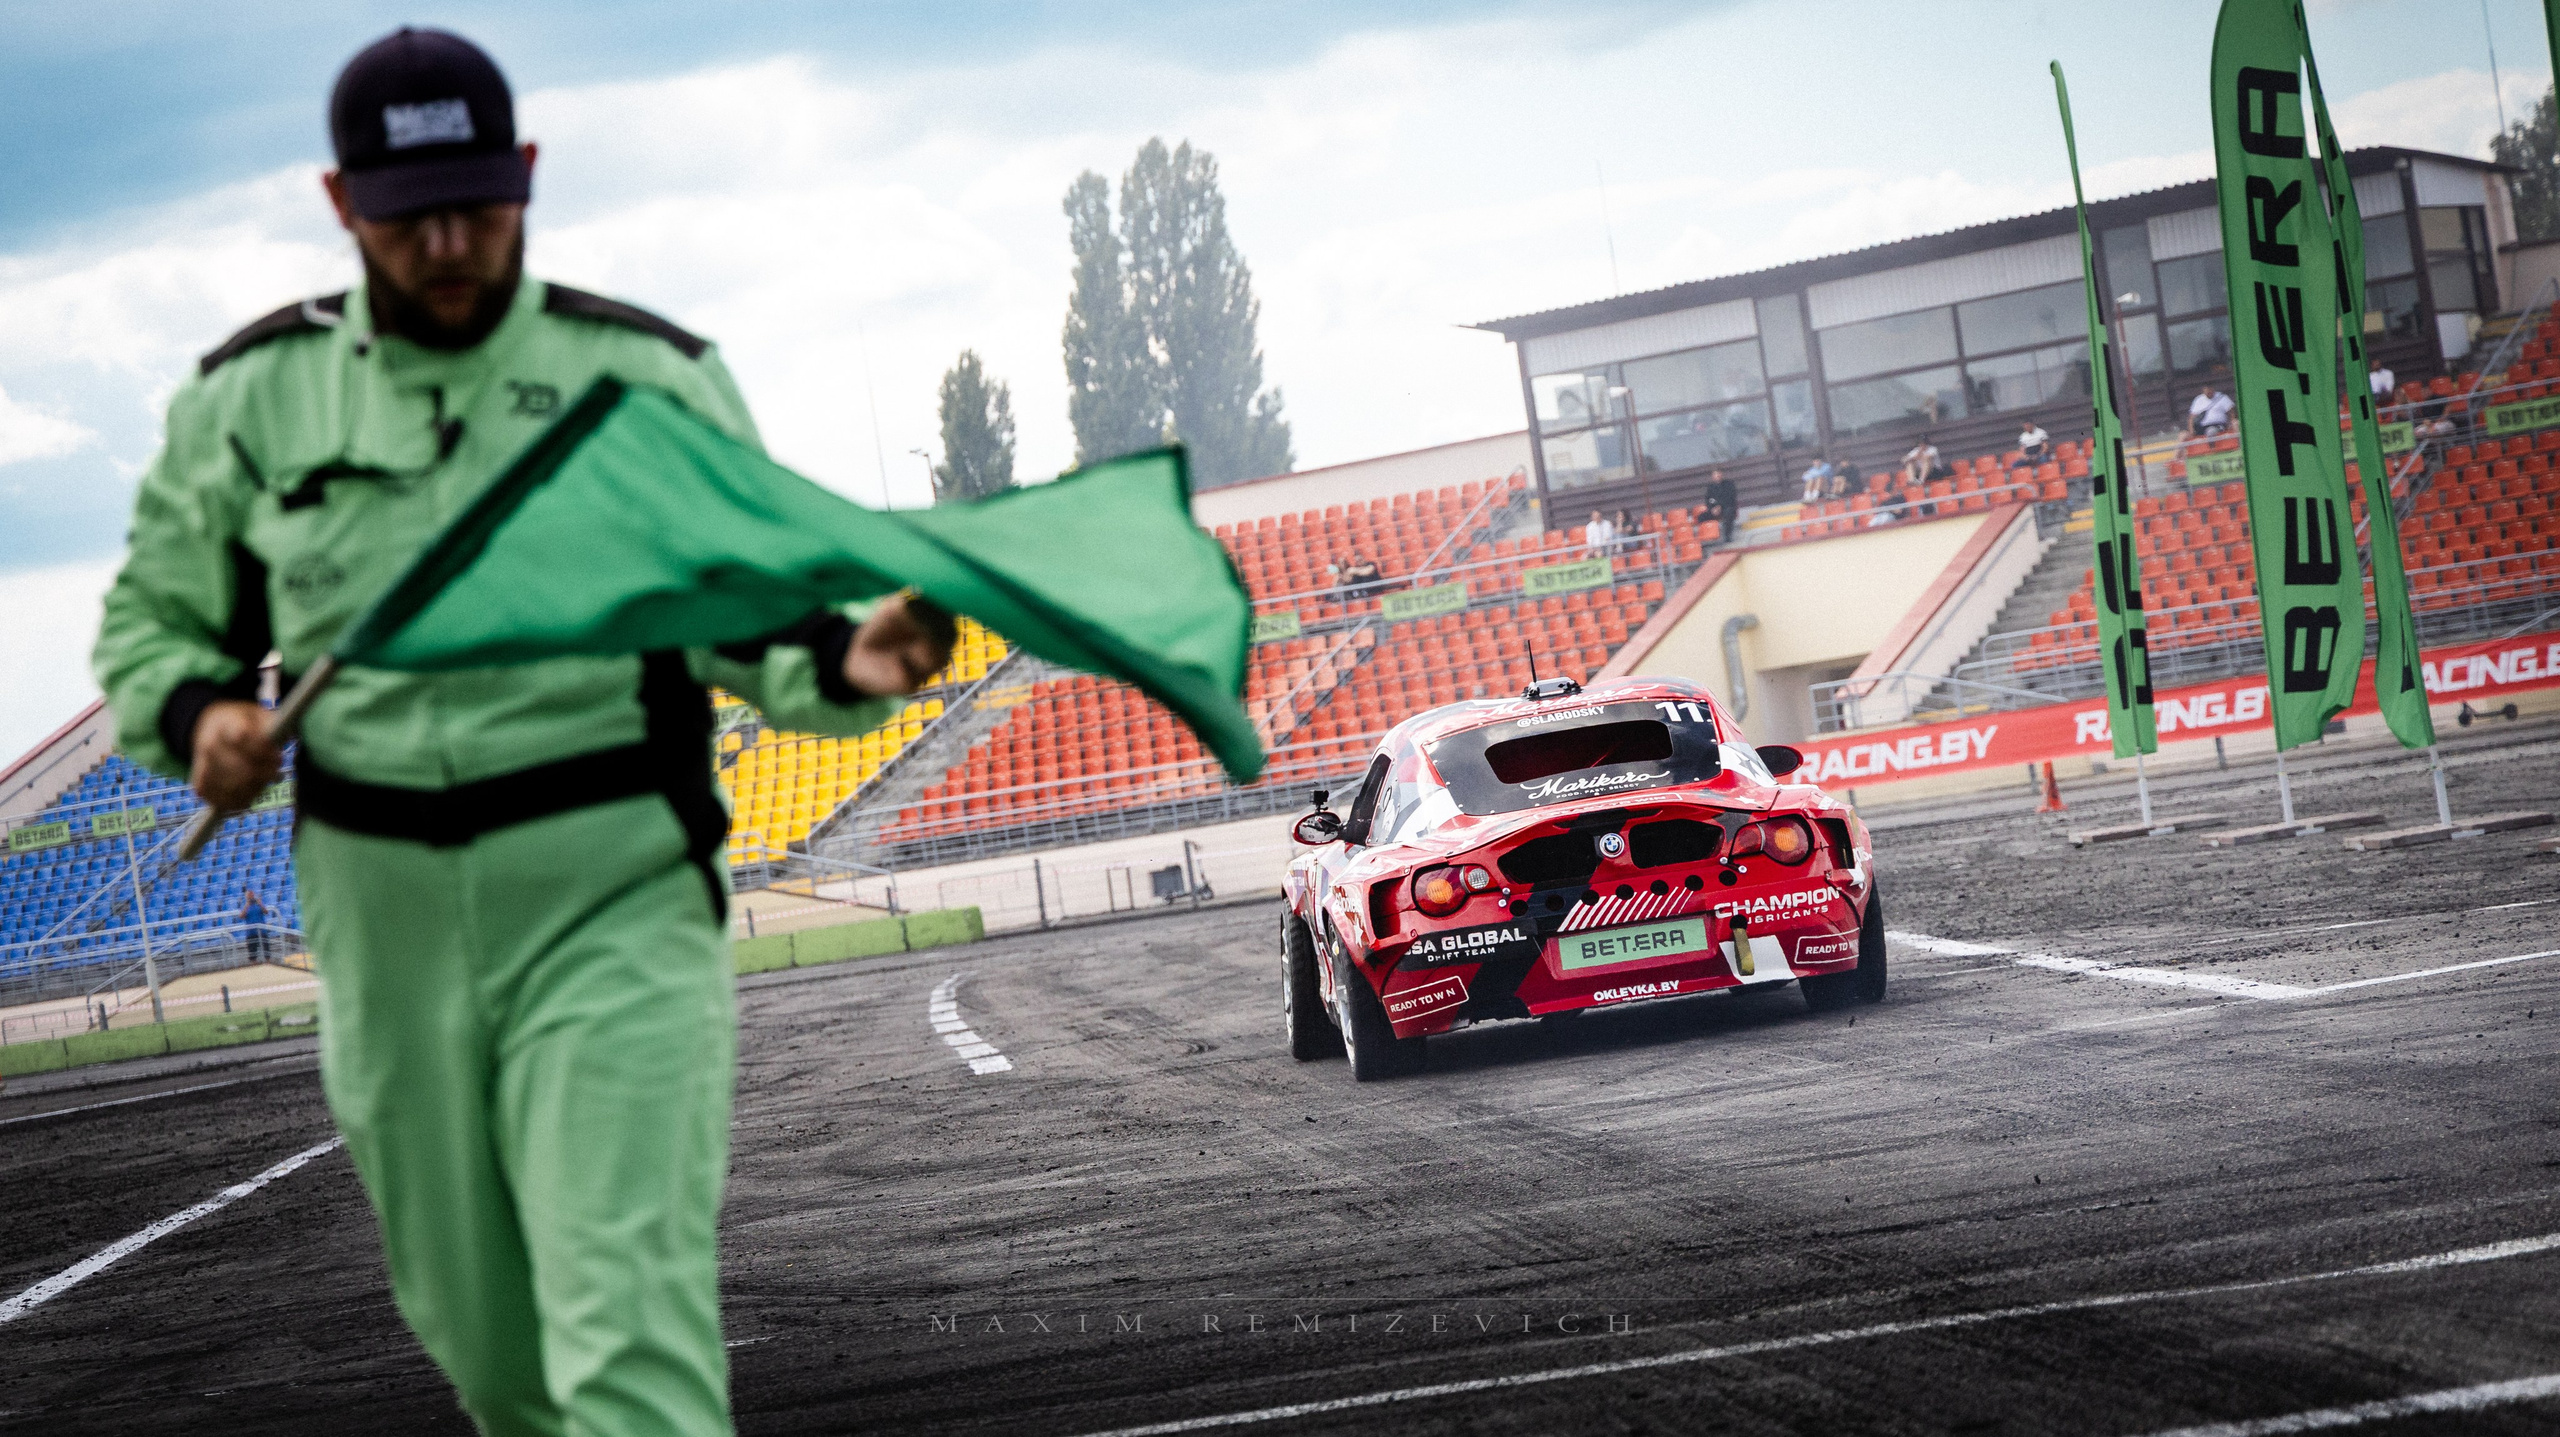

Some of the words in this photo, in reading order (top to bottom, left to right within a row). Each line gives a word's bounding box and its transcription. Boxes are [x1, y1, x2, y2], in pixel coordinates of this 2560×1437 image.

[2422, 642, 2560, 693] ACING.
[1516, 705, 1605, 728] @SLABODSKY
[1655, 701, 1705, 723] 11
[2074, 685, 2270, 744] RING.B
[1791, 724, 1998, 785] RACING.BY
[1520, 771, 1670, 799] Marikaro
[1608, 783, 1640, 791] SELECT
[1713, 885, 1841, 920] CHAMPION
[1746, 905, 1829, 925] BRICANTS
[1441, 928, 1527, 951] GLOBAL
[1805, 944, 1838, 955] READY
[1838, 941, 1848, 952] TO
[1464, 946, 1496, 957] TEAM
[1390, 997, 1417, 1013] READY
[1418, 994, 1433, 1006] TO
[1434, 987, 1456, 1001] WN
[1593, 979, 1680, 1002] OKLEYKA.BY
